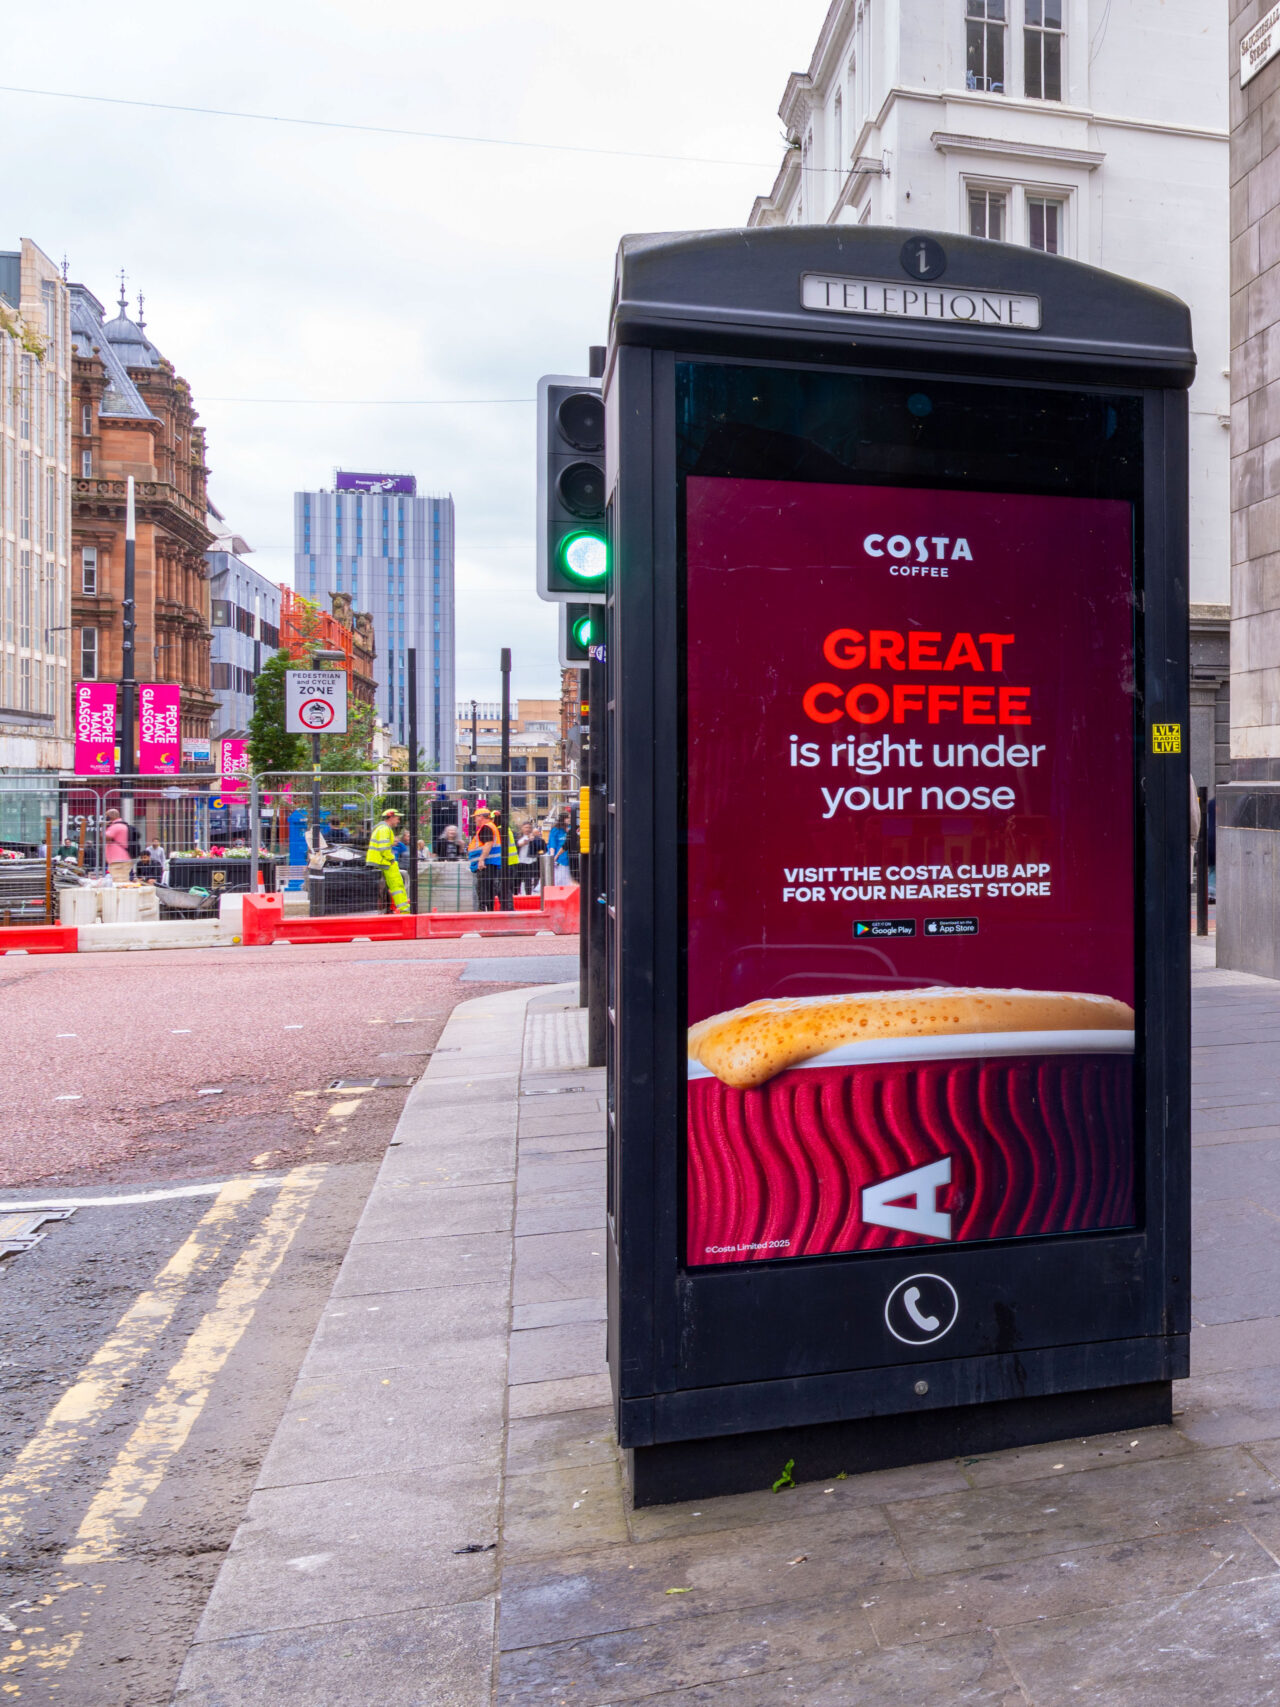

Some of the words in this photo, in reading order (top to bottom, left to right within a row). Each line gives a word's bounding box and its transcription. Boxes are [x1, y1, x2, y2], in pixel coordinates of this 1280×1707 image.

[817, 281, 1024, 325] TELEPHONE
[863, 533, 974, 562] COSTA
[889, 565, 950, 578] COFFEE
[822, 628, 1015, 672] GREAT
[299, 686, 334, 695] ZONE
[802, 682, 1032, 725] COFFEE
[78, 687, 91, 743] GLASGOW
[90, 711, 102, 743] MAKE
[102, 703, 114, 743] PEOPLE
[142, 688, 154, 744] GLASGOW
[154, 713, 166, 744] MAKE
[165, 705, 177, 744] PEOPLE
[1154, 725, 1179, 736] LVLZ
[789, 734, 821, 767] is
[831, 733, 923, 775] right
[933, 735, 1046, 767] under
[1154, 741, 1179, 752] LIVE
[231, 759, 239, 781] MAE
[821, 787, 912, 819] your
[922, 785, 1016, 810] nose
[68, 815, 104, 825] COS
[784, 867, 837, 883] VISIT
[839, 866, 881, 881] THE
[885, 865, 952, 880] COSTA
[957, 863, 1008, 879] CLUB
[1012, 863, 1051, 878] APP
[783, 886, 826, 902] FOR
[829, 885, 886, 901] YOUR
[891, 883, 983, 899] NEAREST
[987, 881, 1051, 898] STORE
[872, 926, 897, 935] Google
[898, 926, 912, 934] Play
[939, 925, 954, 933] App
[955, 924, 975, 932] Store
[862, 1156, 952, 1240] A
[737, 1241, 767, 1251] Limited
[768, 1239, 790, 1248] 2025
